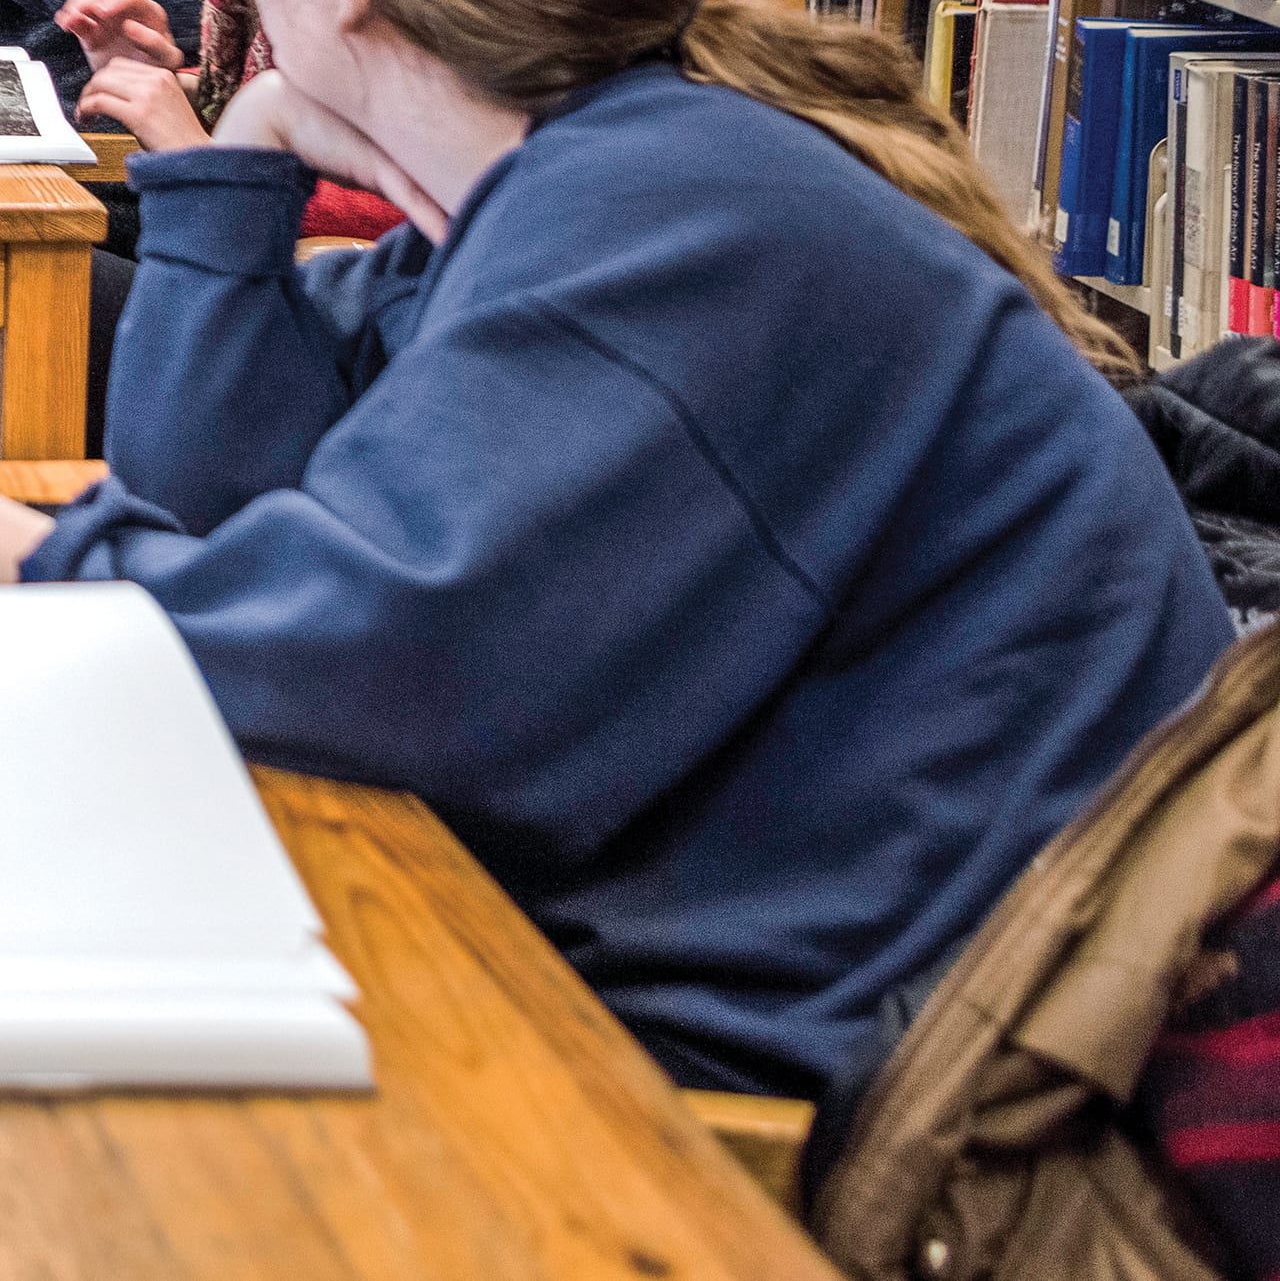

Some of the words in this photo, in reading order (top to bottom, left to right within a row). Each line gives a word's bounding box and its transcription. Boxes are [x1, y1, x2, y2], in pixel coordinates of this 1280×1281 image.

[1233, 133, 1241, 153] The
[1253, 142, 1261, 160] The
[1231, 155, 1240, 193] History
[1251, 162, 1260, 199] History
[1229, 208, 1239, 244] British
[1229, 245, 1237, 262] Art
